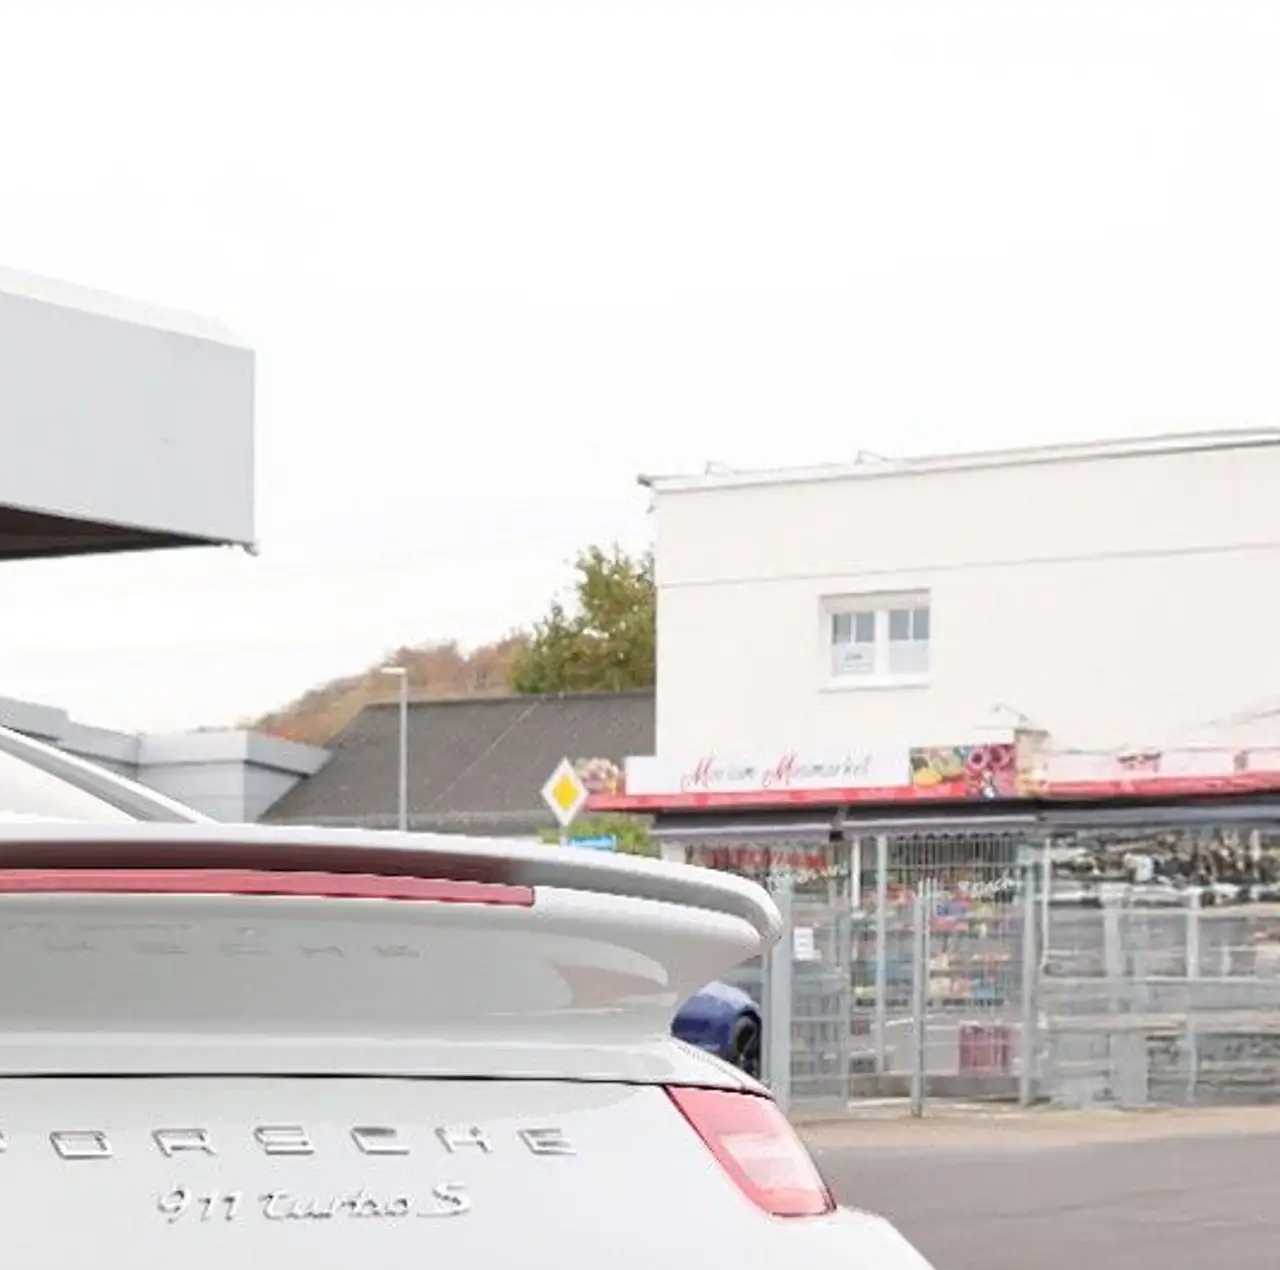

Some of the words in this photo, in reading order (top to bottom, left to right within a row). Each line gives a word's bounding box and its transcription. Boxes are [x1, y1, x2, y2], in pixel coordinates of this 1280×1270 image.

[158, 1188, 239, 1222] 911
[258, 1186, 409, 1220] turbo
[416, 1180, 470, 1218] S
